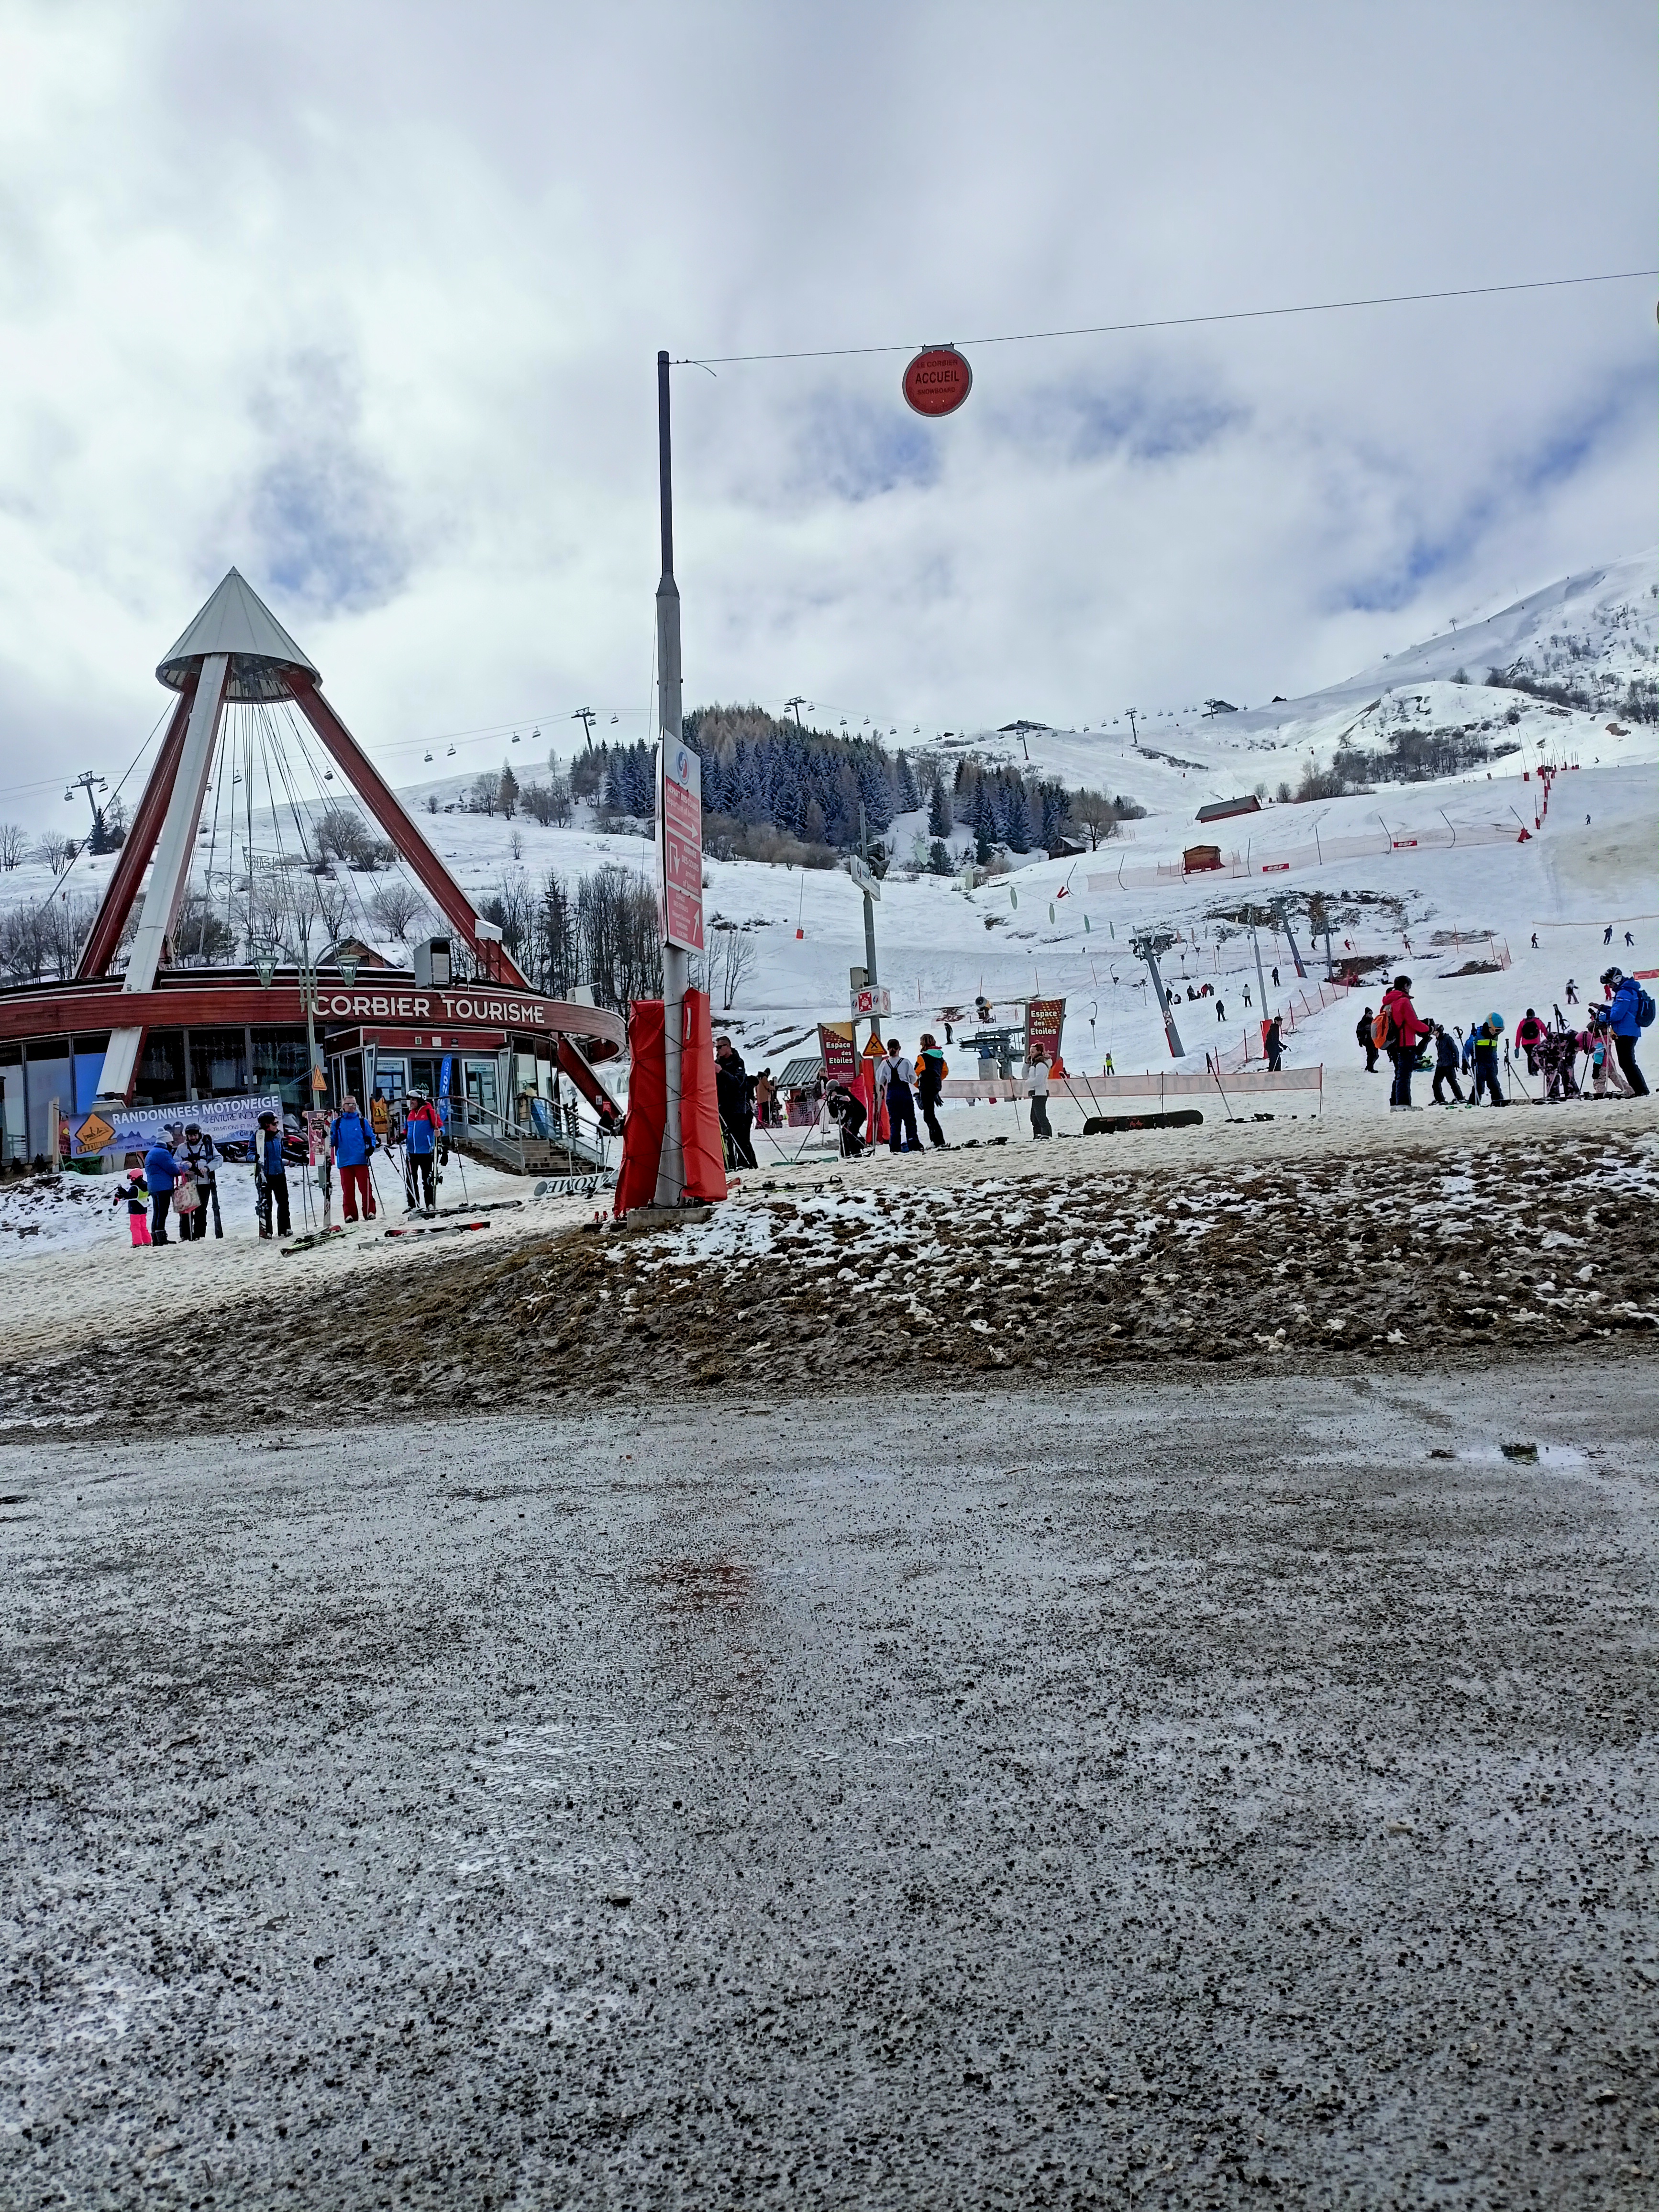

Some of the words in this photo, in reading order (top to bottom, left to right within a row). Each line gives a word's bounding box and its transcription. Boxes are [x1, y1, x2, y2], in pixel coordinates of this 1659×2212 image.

[927, 359, 958, 367] CORBIER
[916, 370, 960, 384] ACCUEIL
[918, 387, 956, 395] SNOWBOARD
[687, 798, 698, 812] COURS
[311, 995, 430, 1017] CORBIER
[442, 999, 544, 1024] TOURISME
[1031, 1010, 1057, 1018] Espace
[112, 1105, 199, 1125] RANDONNEES
[202, 1095, 279, 1115] MOTONEIGE
[198, 1112, 237, 1124] L'AVENTURE
[546, 1175, 600, 1194] ROME
